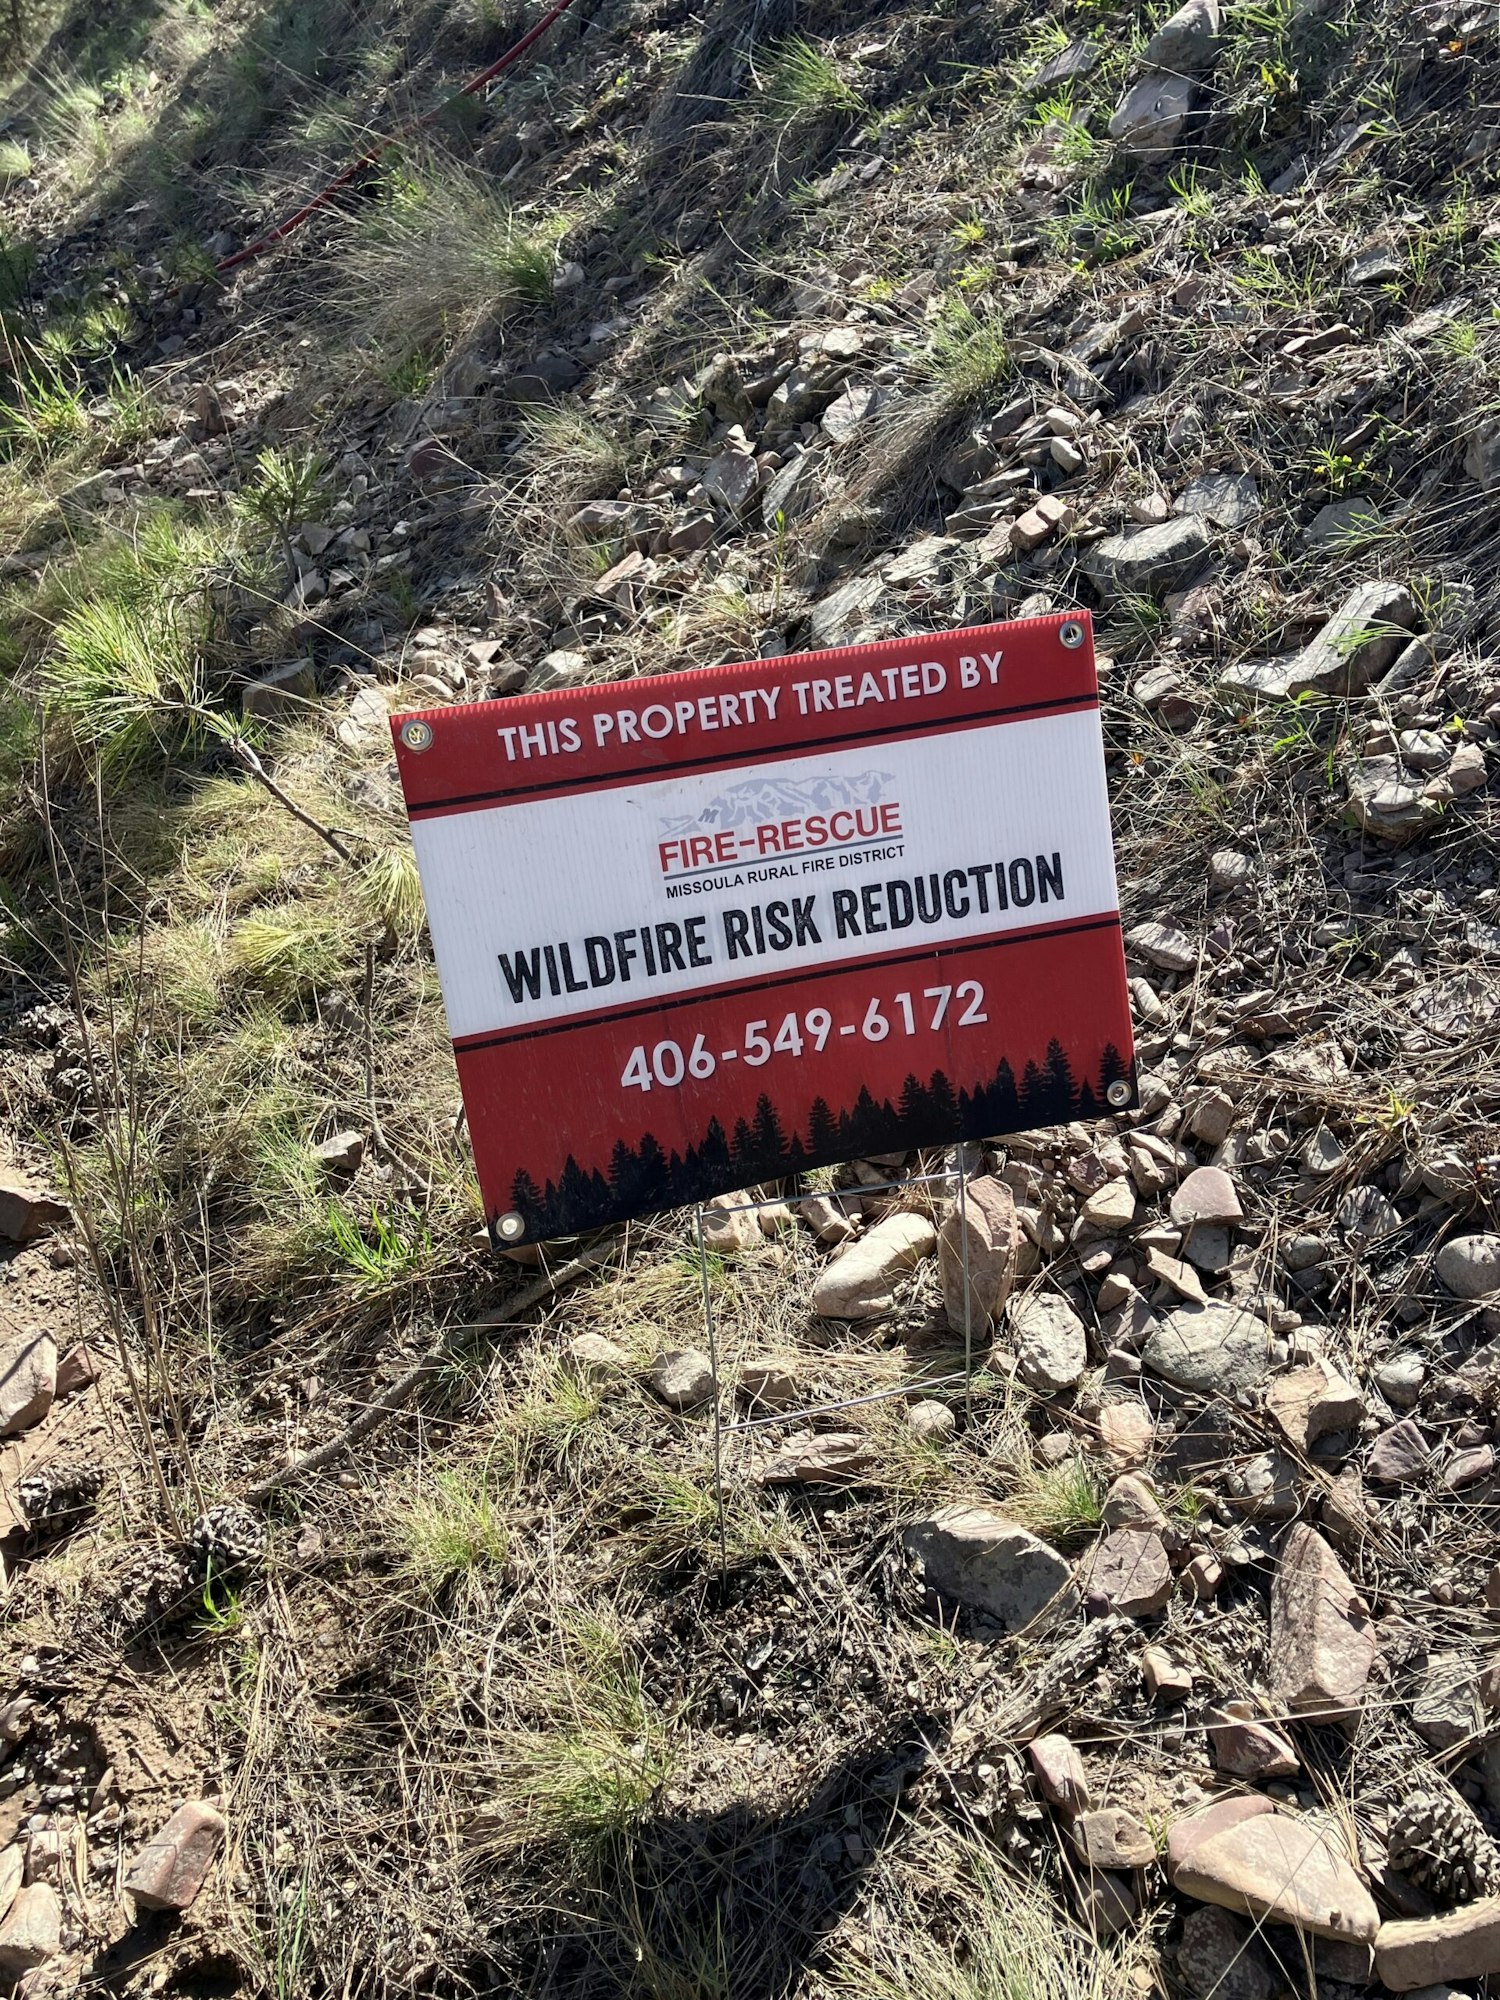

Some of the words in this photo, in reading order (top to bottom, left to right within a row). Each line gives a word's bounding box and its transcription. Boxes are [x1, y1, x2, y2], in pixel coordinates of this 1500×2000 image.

[498, 717, 582, 762] THIS
[595, 687, 782, 745] PROPERTY
[793, 660, 948, 717] TREATED
[960, 651, 1003, 688] BY
[658, 802, 903, 873] FIRE-RESCUE
[666, 874, 744, 899] MISSOULA
[747, 864, 798, 884] RURAL
[802, 857, 835, 874] FIRE
[839, 845, 905, 867] DISTRICT
[498, 916, 712, 1004] WILDFIRE
[722, 895, 824, 961] RISK
[832, 852, 1065, 940] REDUCTION
[620, 980, 988, 1092] 406-549-6172
